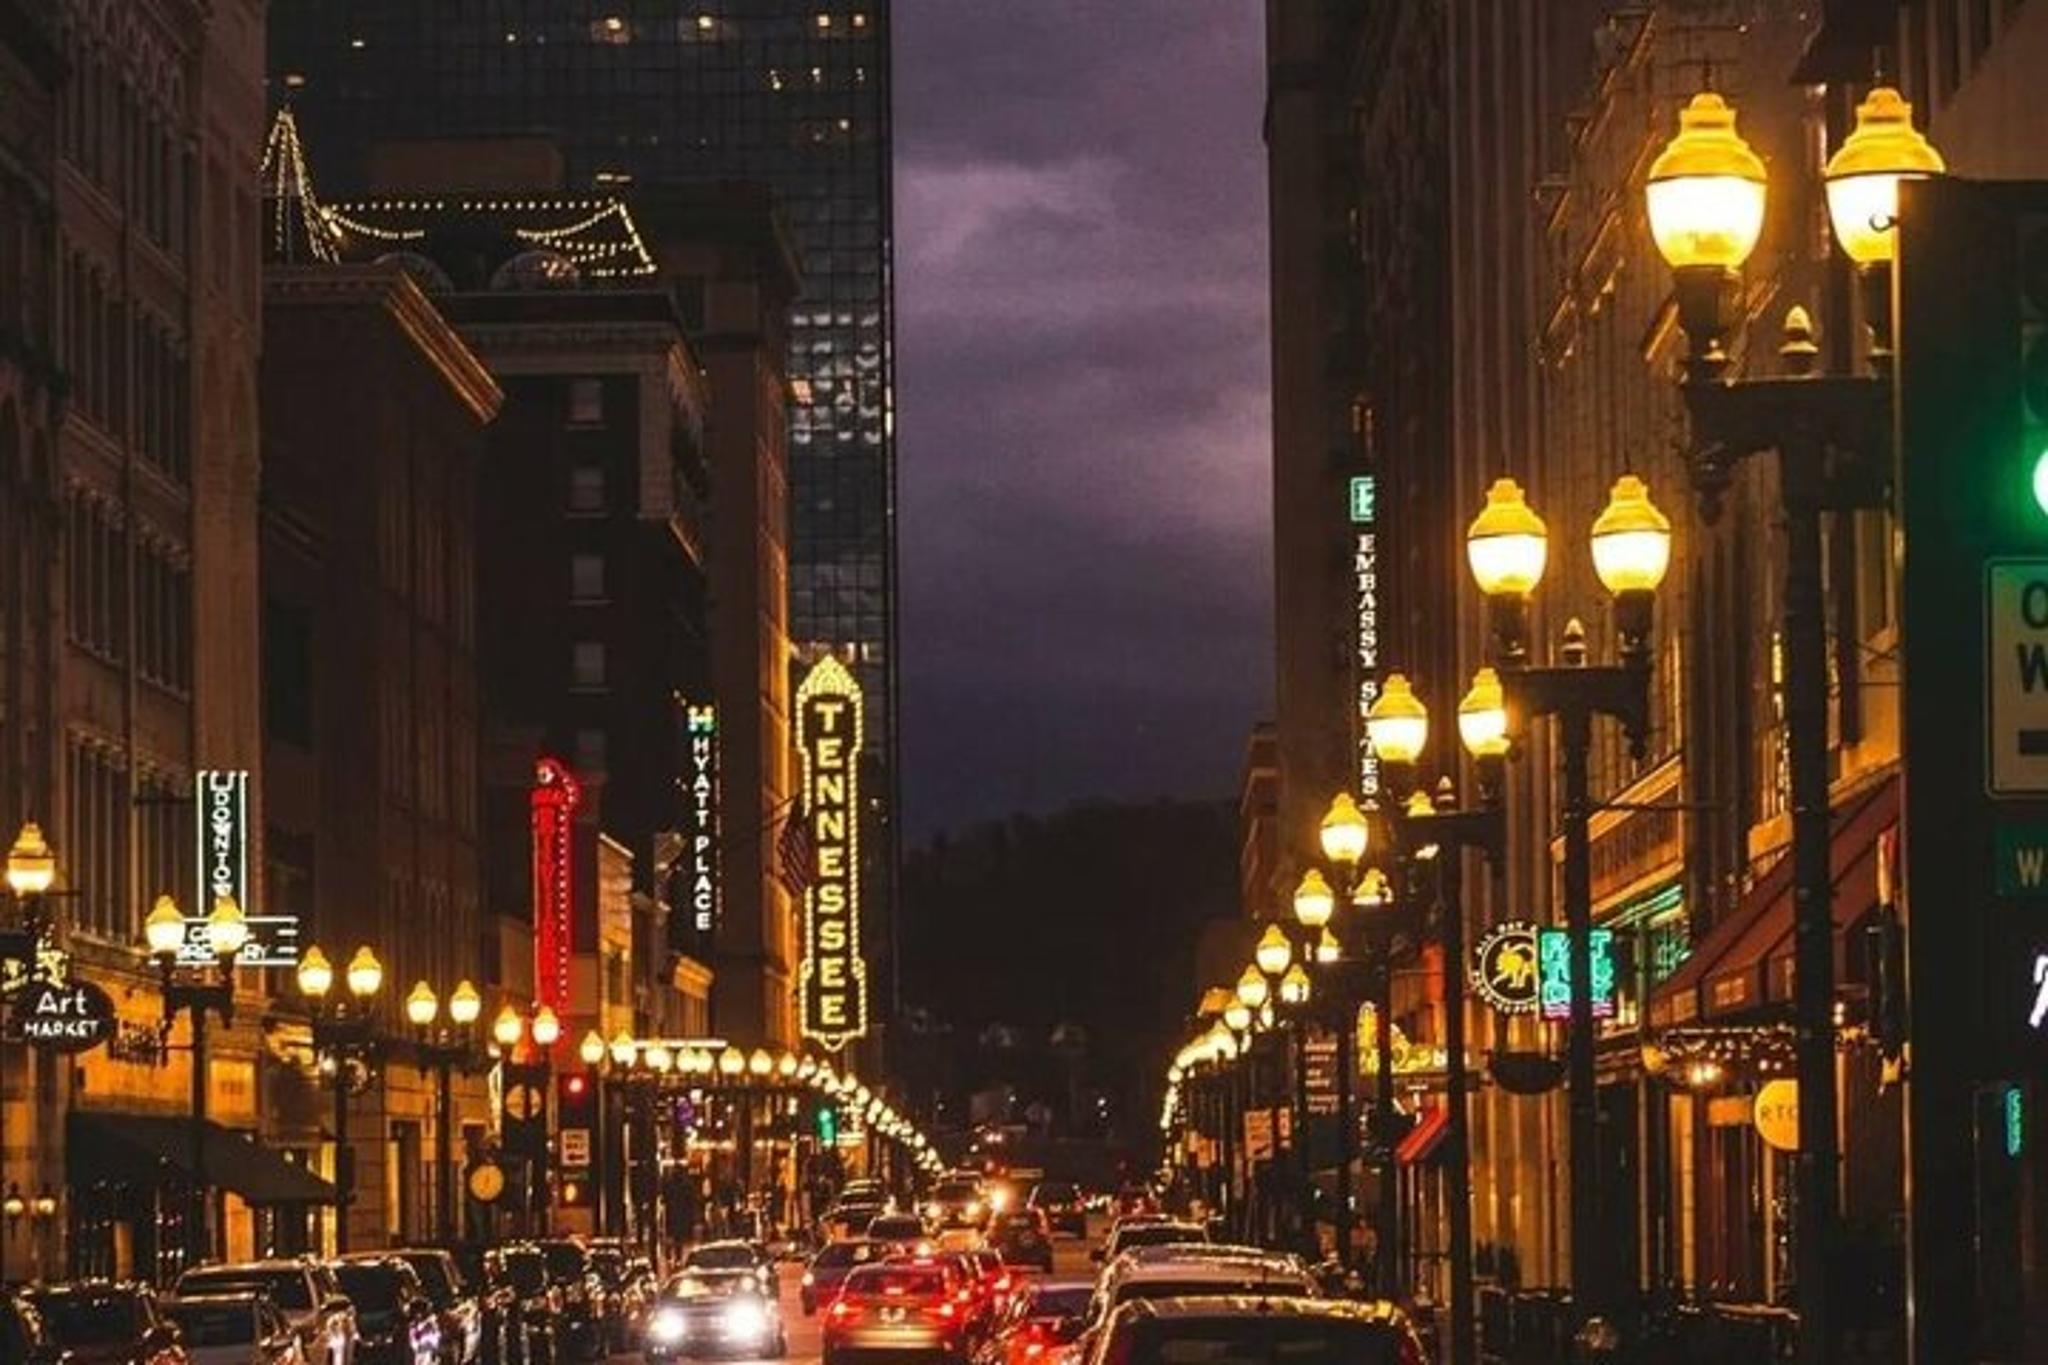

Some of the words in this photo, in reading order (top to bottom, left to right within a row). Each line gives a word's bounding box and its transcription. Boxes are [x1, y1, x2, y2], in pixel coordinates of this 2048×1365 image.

[1356, 533, 1377, 668] EMBASSY
[692, 736, 710, 828] HYATT
[693, 835, 712, 931] PLACE
[814, 701, 847, 1026] TENNESSEE
[24, 1019, 100, 1037] MARKET
[35, 989, 87, 1014] Art
